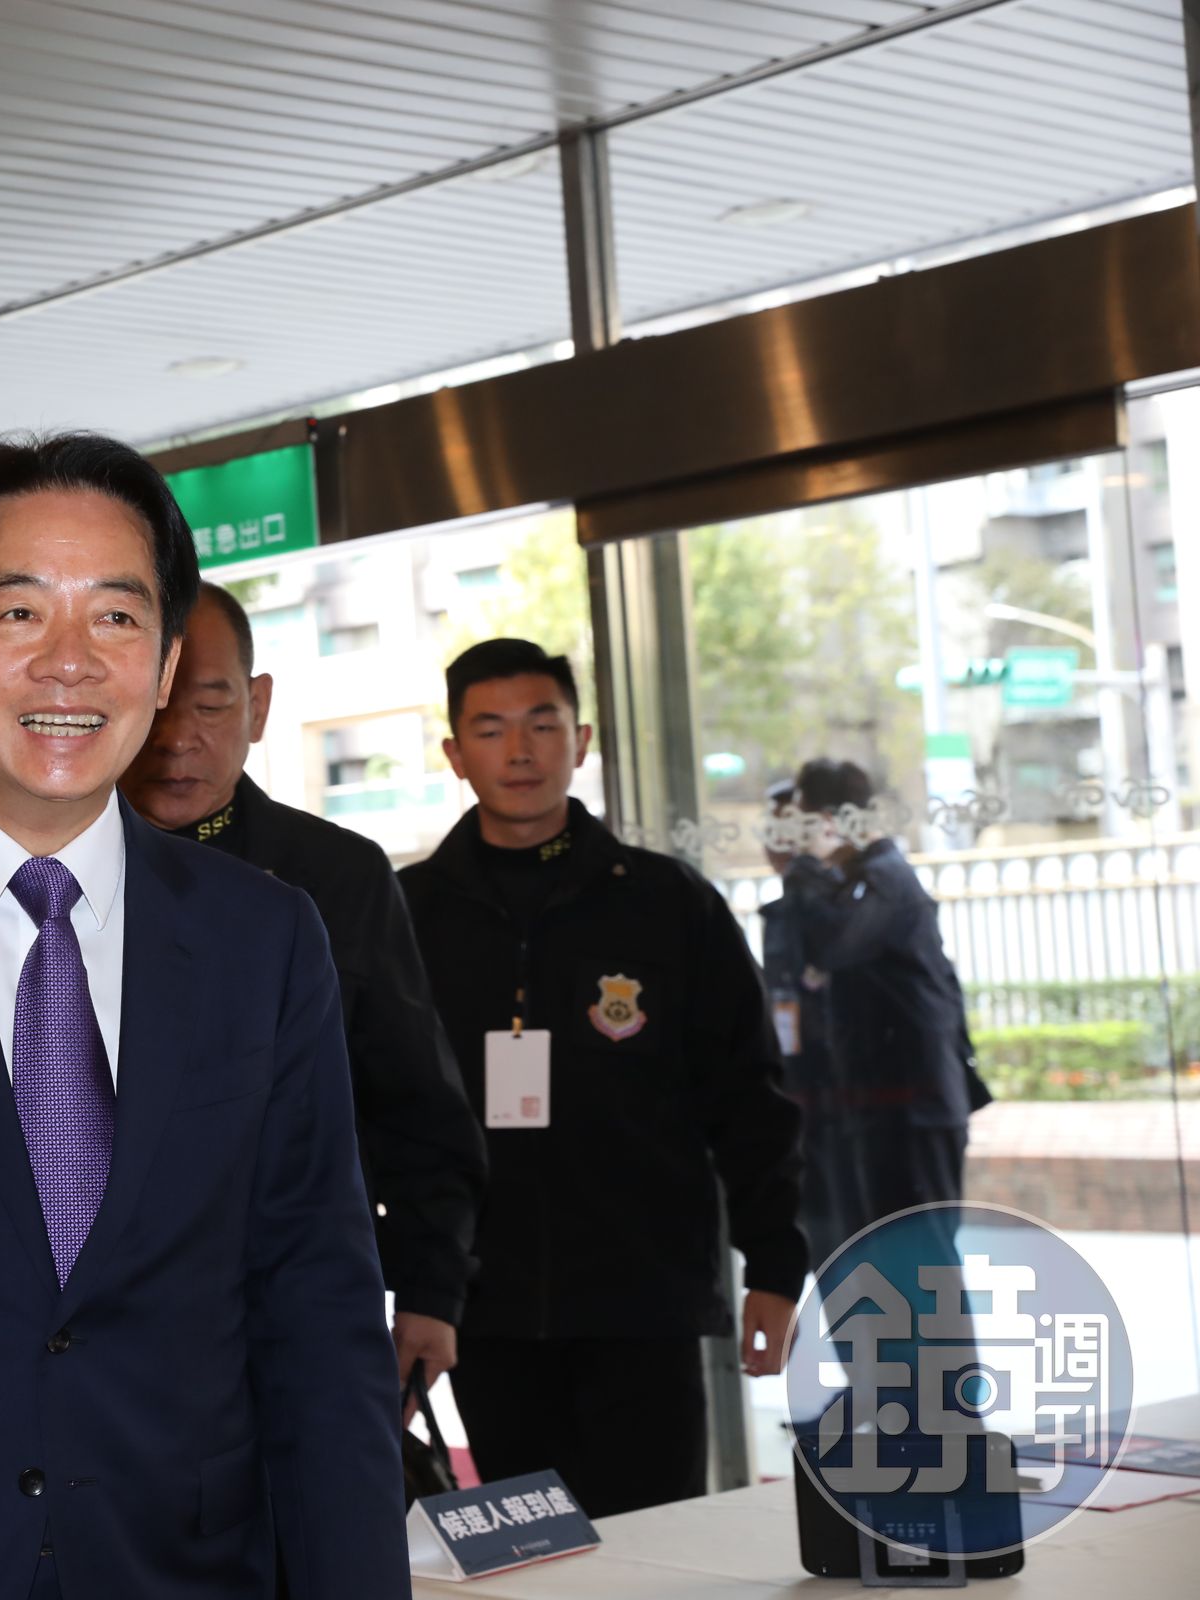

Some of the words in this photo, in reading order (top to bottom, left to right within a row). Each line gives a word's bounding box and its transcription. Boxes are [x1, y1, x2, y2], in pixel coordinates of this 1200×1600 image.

[197, 805, 234, 842] SSC
[437, 1486, 577, 1541] 候選人報到處
